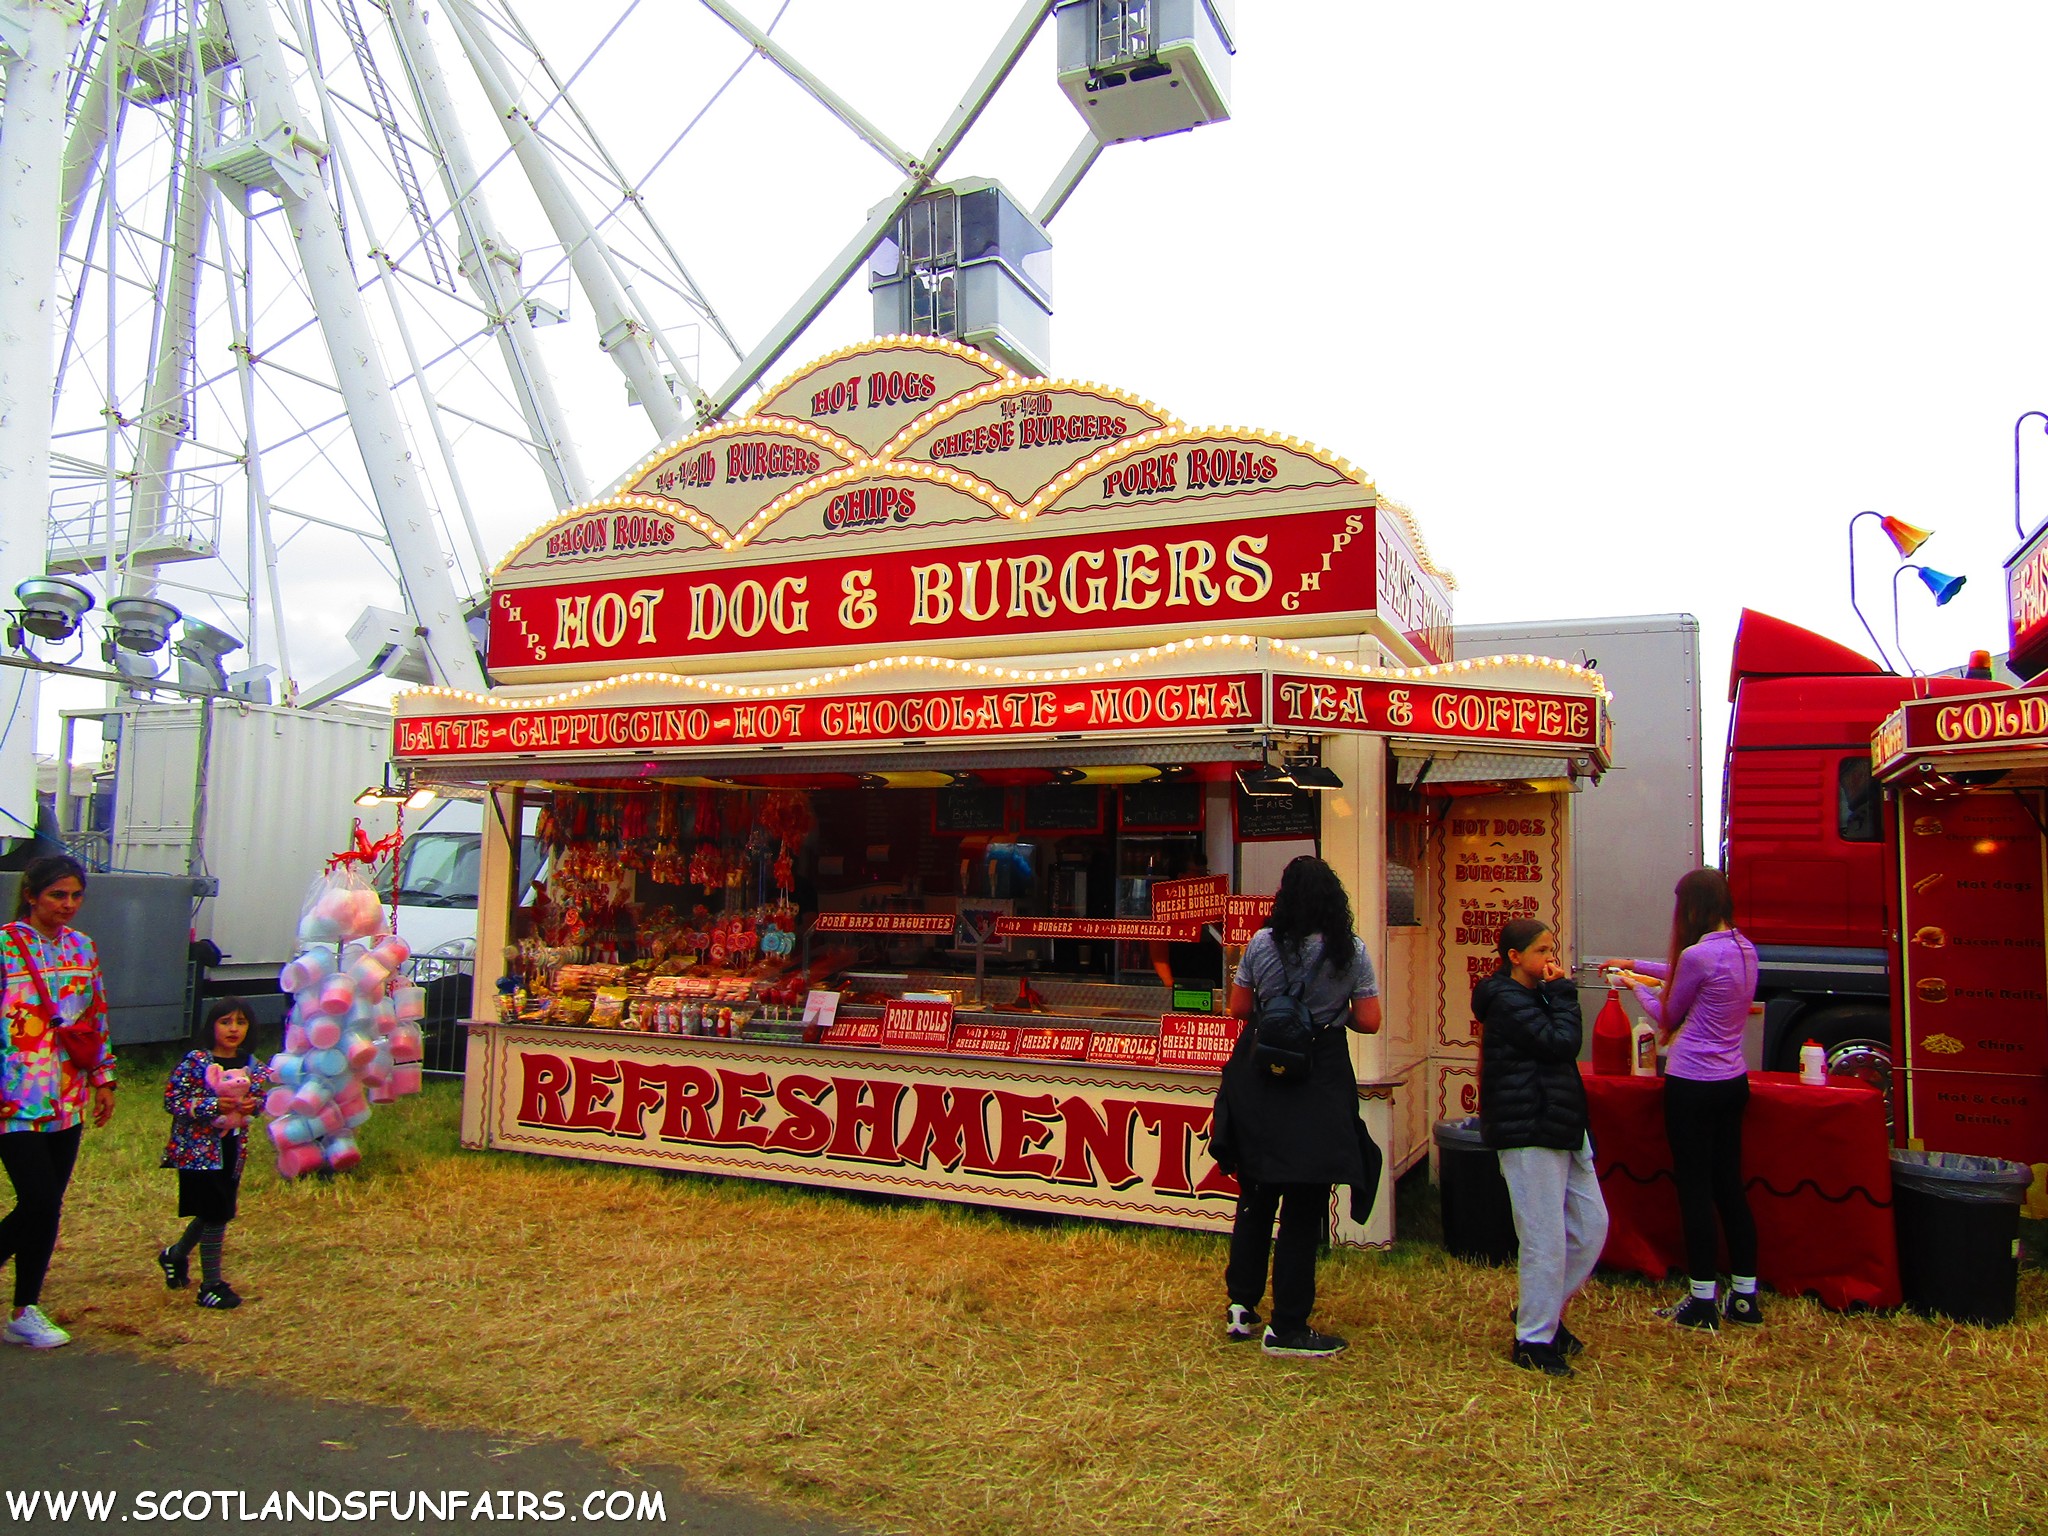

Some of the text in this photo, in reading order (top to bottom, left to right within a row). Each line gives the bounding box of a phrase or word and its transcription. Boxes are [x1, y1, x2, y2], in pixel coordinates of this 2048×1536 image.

[811, 370, 937, 416] HOT DOGS
[929, 414, 1128, 459] CHEESE BURGERS
[725, 442, 822, 484] BURGERS
[1102, 448, 1279, 499] PORK ROLLS
[823, 487, 917, 531] CHIPS
[546, 514, 676, 558] BACON ROLLS
[1280, 513, 1365, 611] CHIPS
[552, 533, 1274, 652] HOT DOG & BURGERS
[499, 593, 547, 662] CHIPS
[1280, 681, 1591, 738] TEA & COFFEE
[1936, 697, 2048, 742] COLD
[1452, 818, 1546, 836] HOT DOGS
[1455, 864, 1543, 882] BURGERS
[1188, 881, 1216, 896] BACON
[1956, 878, 2032, 892] Hot dogs
[1155, 894, 1224, 914] CHEESE BURGERS
[1228, 900, 1256, 916] GRAVY
[821, 916, 951, 930] PORK BAPS OR BAGUETTES
[1171, 911, 1180, 921] OR
[1180, 909, 1204, 919] WITHOUT
[1238, 916, 1244, 928] &
[1037, 922, 1073, 933] BURGERS
[1117, 924, 1139, 935] BACON
[1231, 928, 1252, 941] CHIPS
[1952, 936, 2044, 949] Bacon Rolls
[1954, 987, 2044, 1001] Pork Rolls
[887, 1008, 949, 1033] PORK ROLLS
[1197, 1021, 1226, 1036] BACON
[858, 1024, 880, 1038] CHIPS
[886, 1030, 898, 1039] WITH
[904, 1031, 924, 1041] WITHOUT
[955, 1038, 1011, 1051] CHEESE BURGERS
[1021, 1035, 1085, 1051] CHEESE & CHIPS
[1092, 1036, 1158, 1055] PORK ROLLS
[1162, 1034, 1235, 1052] CHEESE BURGERS
[1976, 1038, 2025, 1052] Chips
[1162, 1049, 1177, 1059] WITH
[1177, 1050, 1185, 1060] OR
[1185, 1050, 1211, 1061] WITHOUT
[1937, 1091, 1970, 1103] Hot
[1991, 1094, 2029, 1106] Cold
[1954, 1112, 2012, 1126] Drinks
